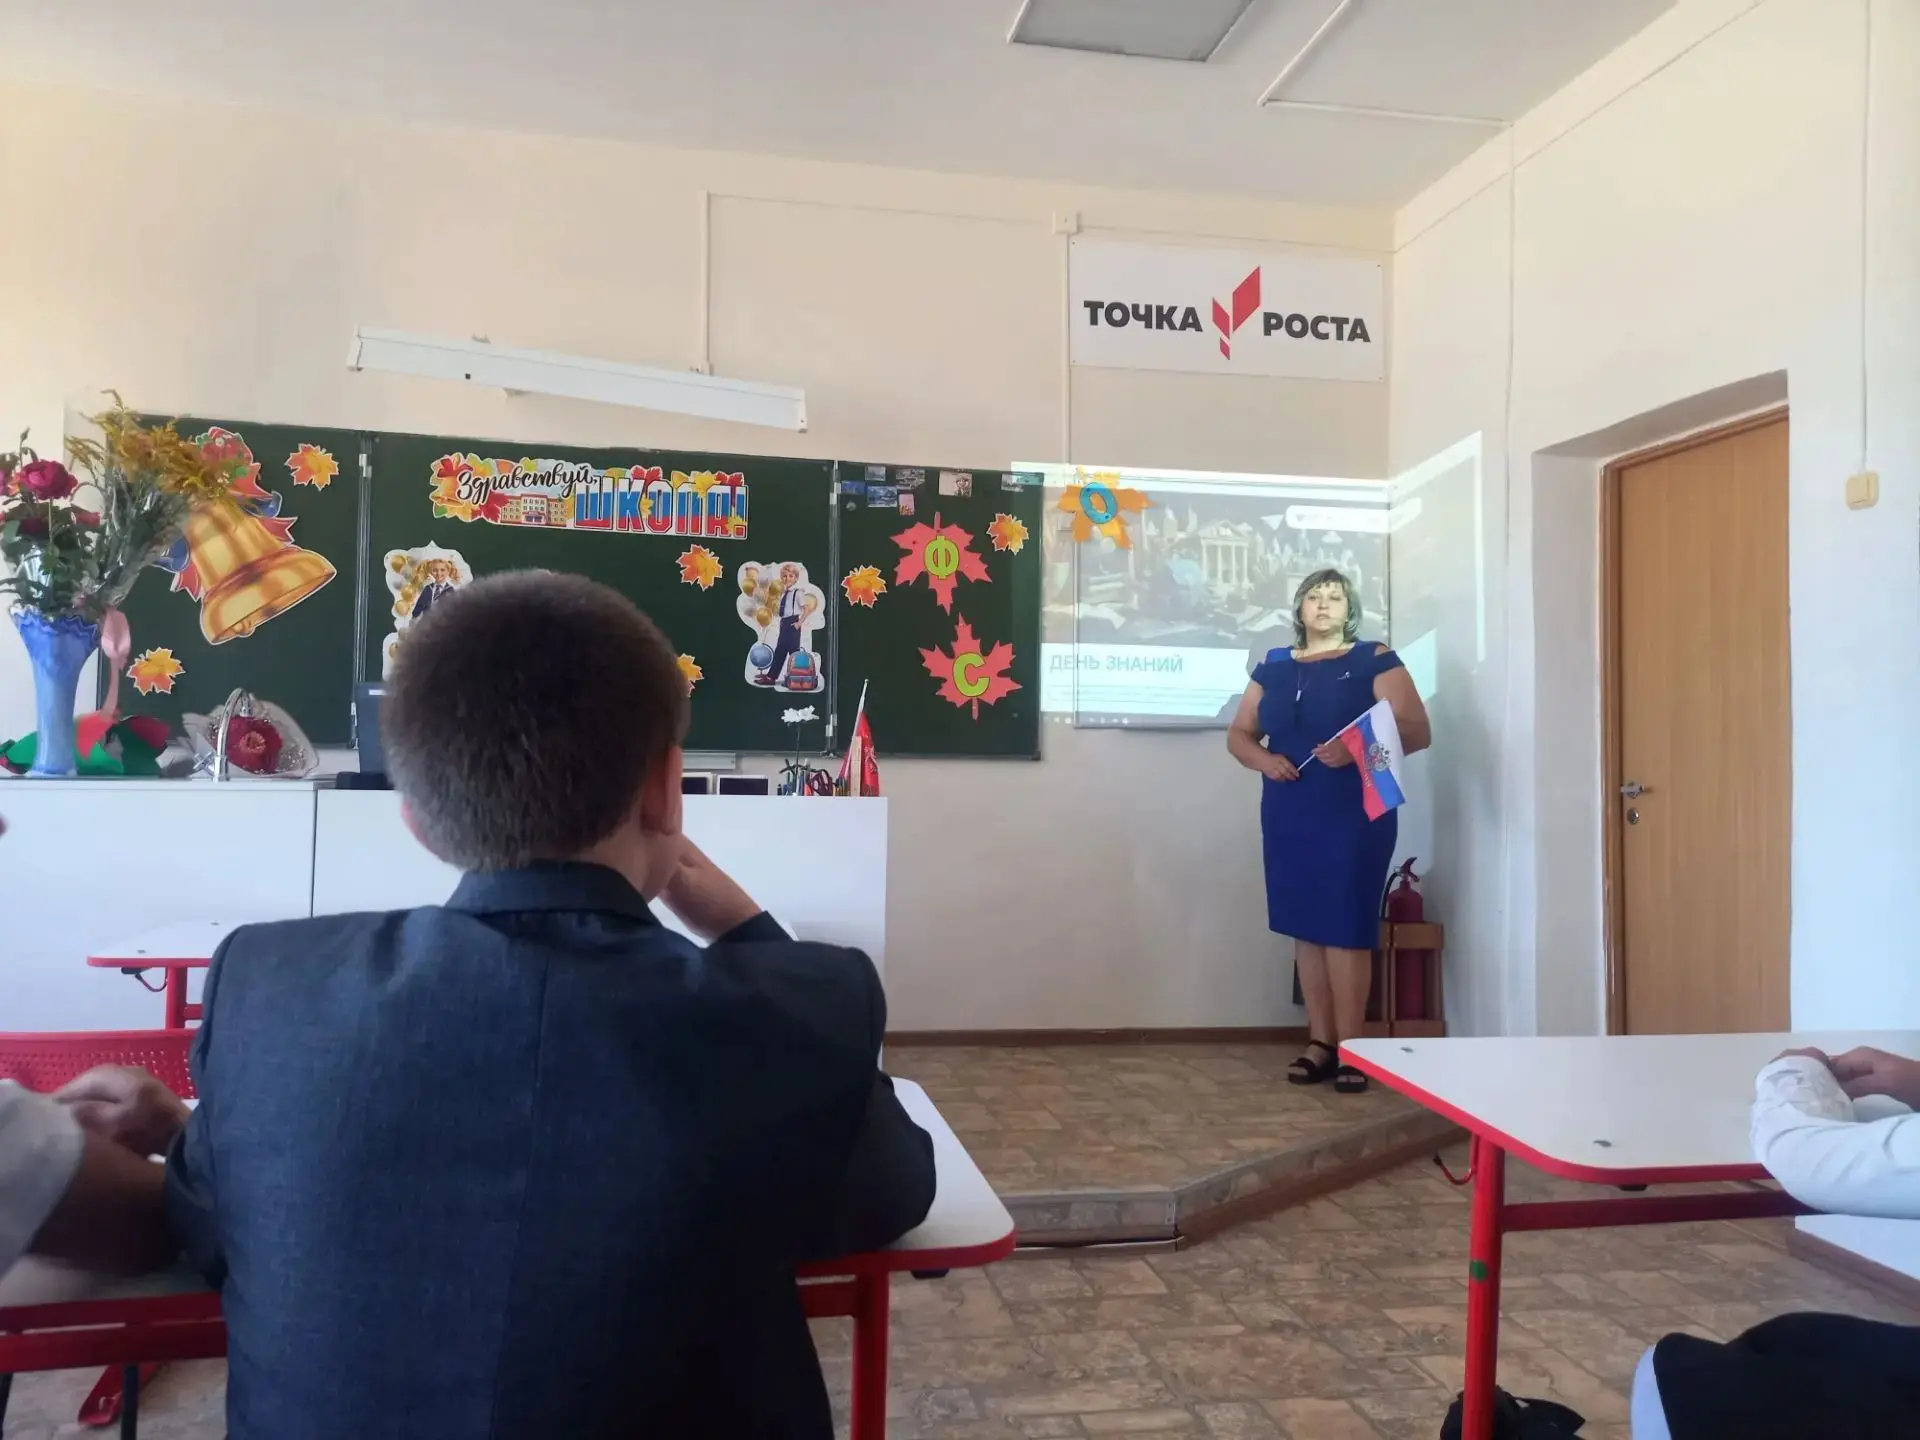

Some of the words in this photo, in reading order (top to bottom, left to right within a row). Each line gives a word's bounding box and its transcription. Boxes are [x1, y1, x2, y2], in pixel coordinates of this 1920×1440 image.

[1083, 300, 1203, 332] ТОЧКА
[1263, 312, 1371, 343] РОСТА
[457, 462, 597, 504] Здравствуй,
[574, 475, 747, 538] ШКОЛА!
[923, 535, 959, 580] Ф
[952, 652, 990, 697] С
[1050, 653, 1101, 672] ДЕНЬ
[1105, 654, 1184, 674] ЗНАНИЙ
